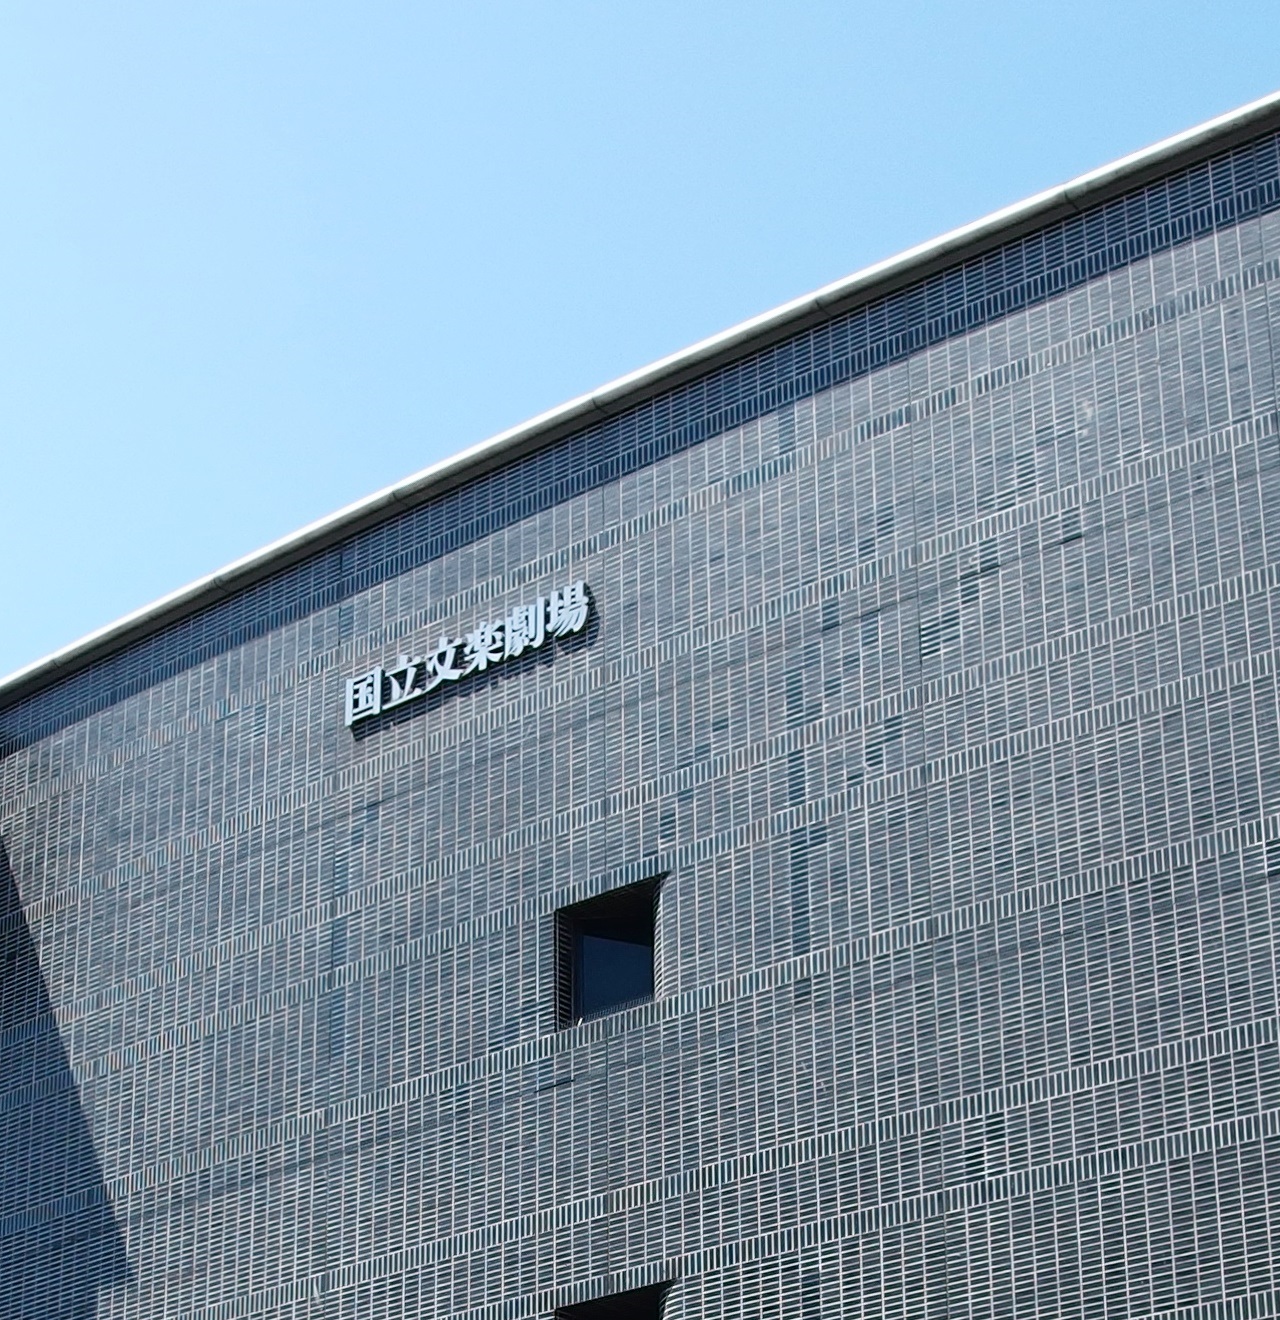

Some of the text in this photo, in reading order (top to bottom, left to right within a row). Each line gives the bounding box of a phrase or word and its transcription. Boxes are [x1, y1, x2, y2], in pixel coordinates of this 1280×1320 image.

[344, 580, 590, 728] 国立文楽劇場
